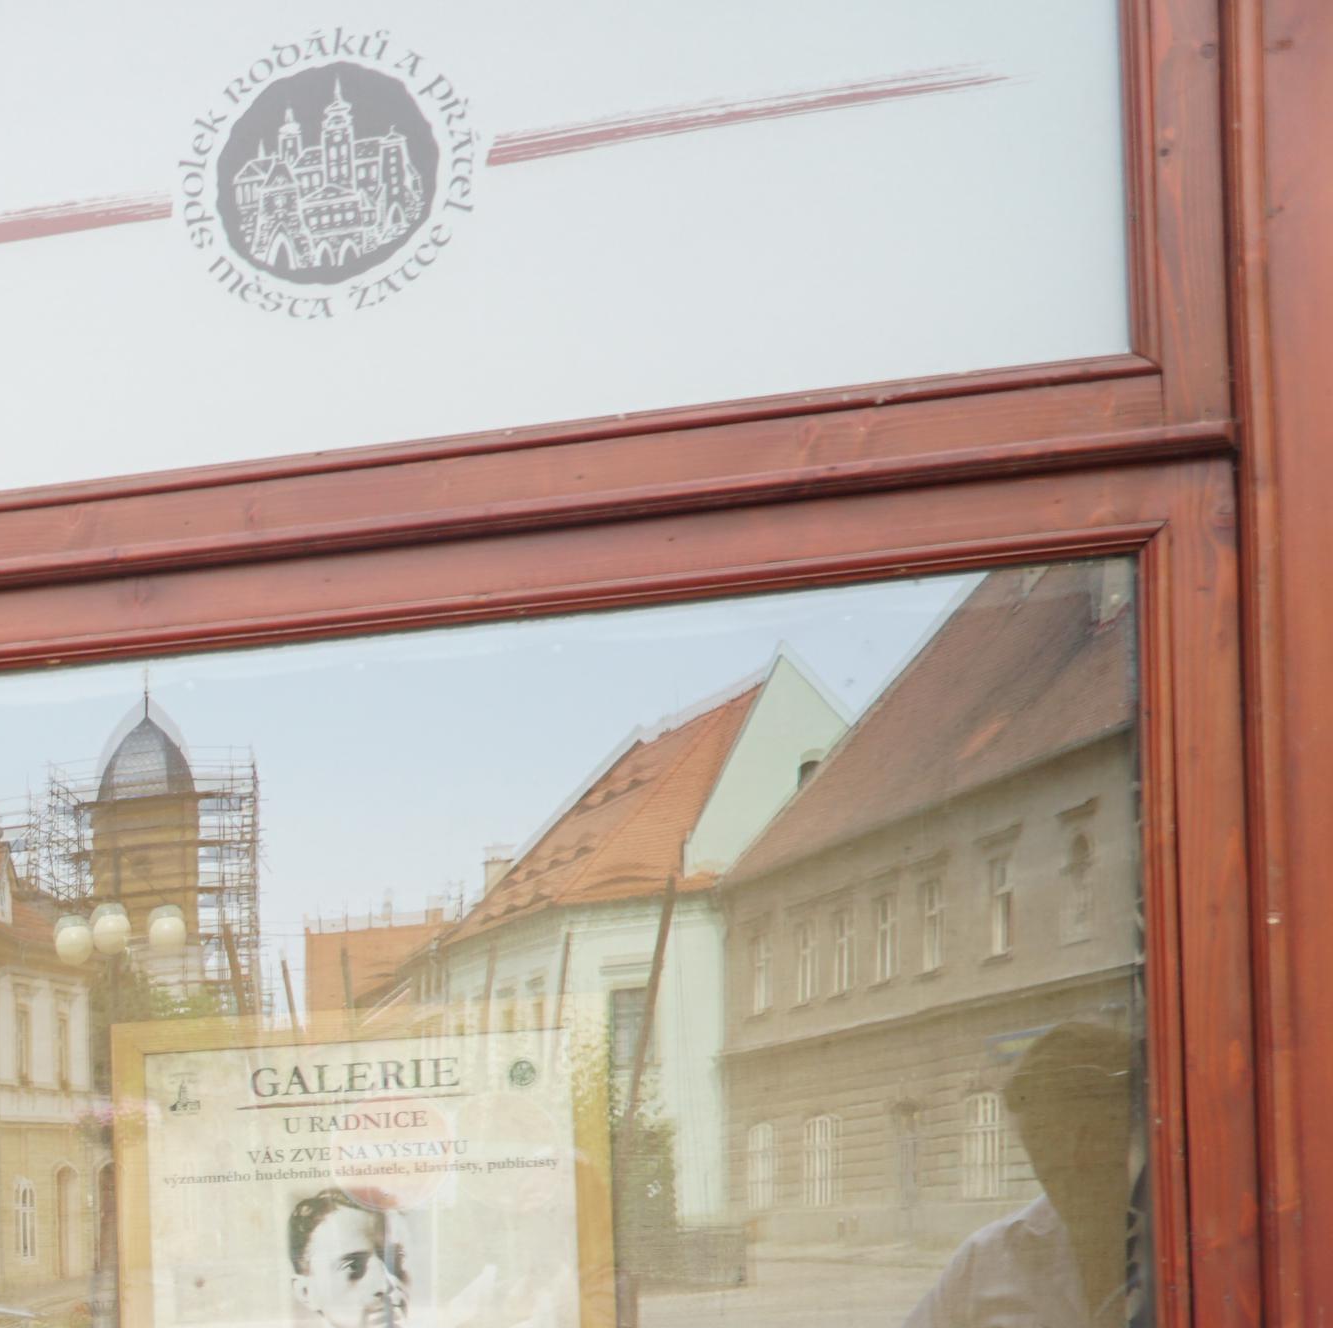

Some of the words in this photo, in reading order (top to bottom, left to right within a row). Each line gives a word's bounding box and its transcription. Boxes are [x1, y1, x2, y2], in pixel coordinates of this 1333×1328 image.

[251, 1056, 460, 1098] GALERIE
[284, 1116, 302, 1135] U
[309, 1110, 429, 1133] RADNICE
[247, 1145, 286, 1165] VÁS
[290, 1146, 331, 1163] ZVE
[337, 1144, 369, 1161] NA
[373, 1138, 470, 1159] VÝSTAVU
[163, 1168, 252, 1188] významného
[255, 1165, 331, 1183] hudebního
[334, 1162, 411, 1180] skladatele,
[487, 1153, 560, 1174] publicisty
